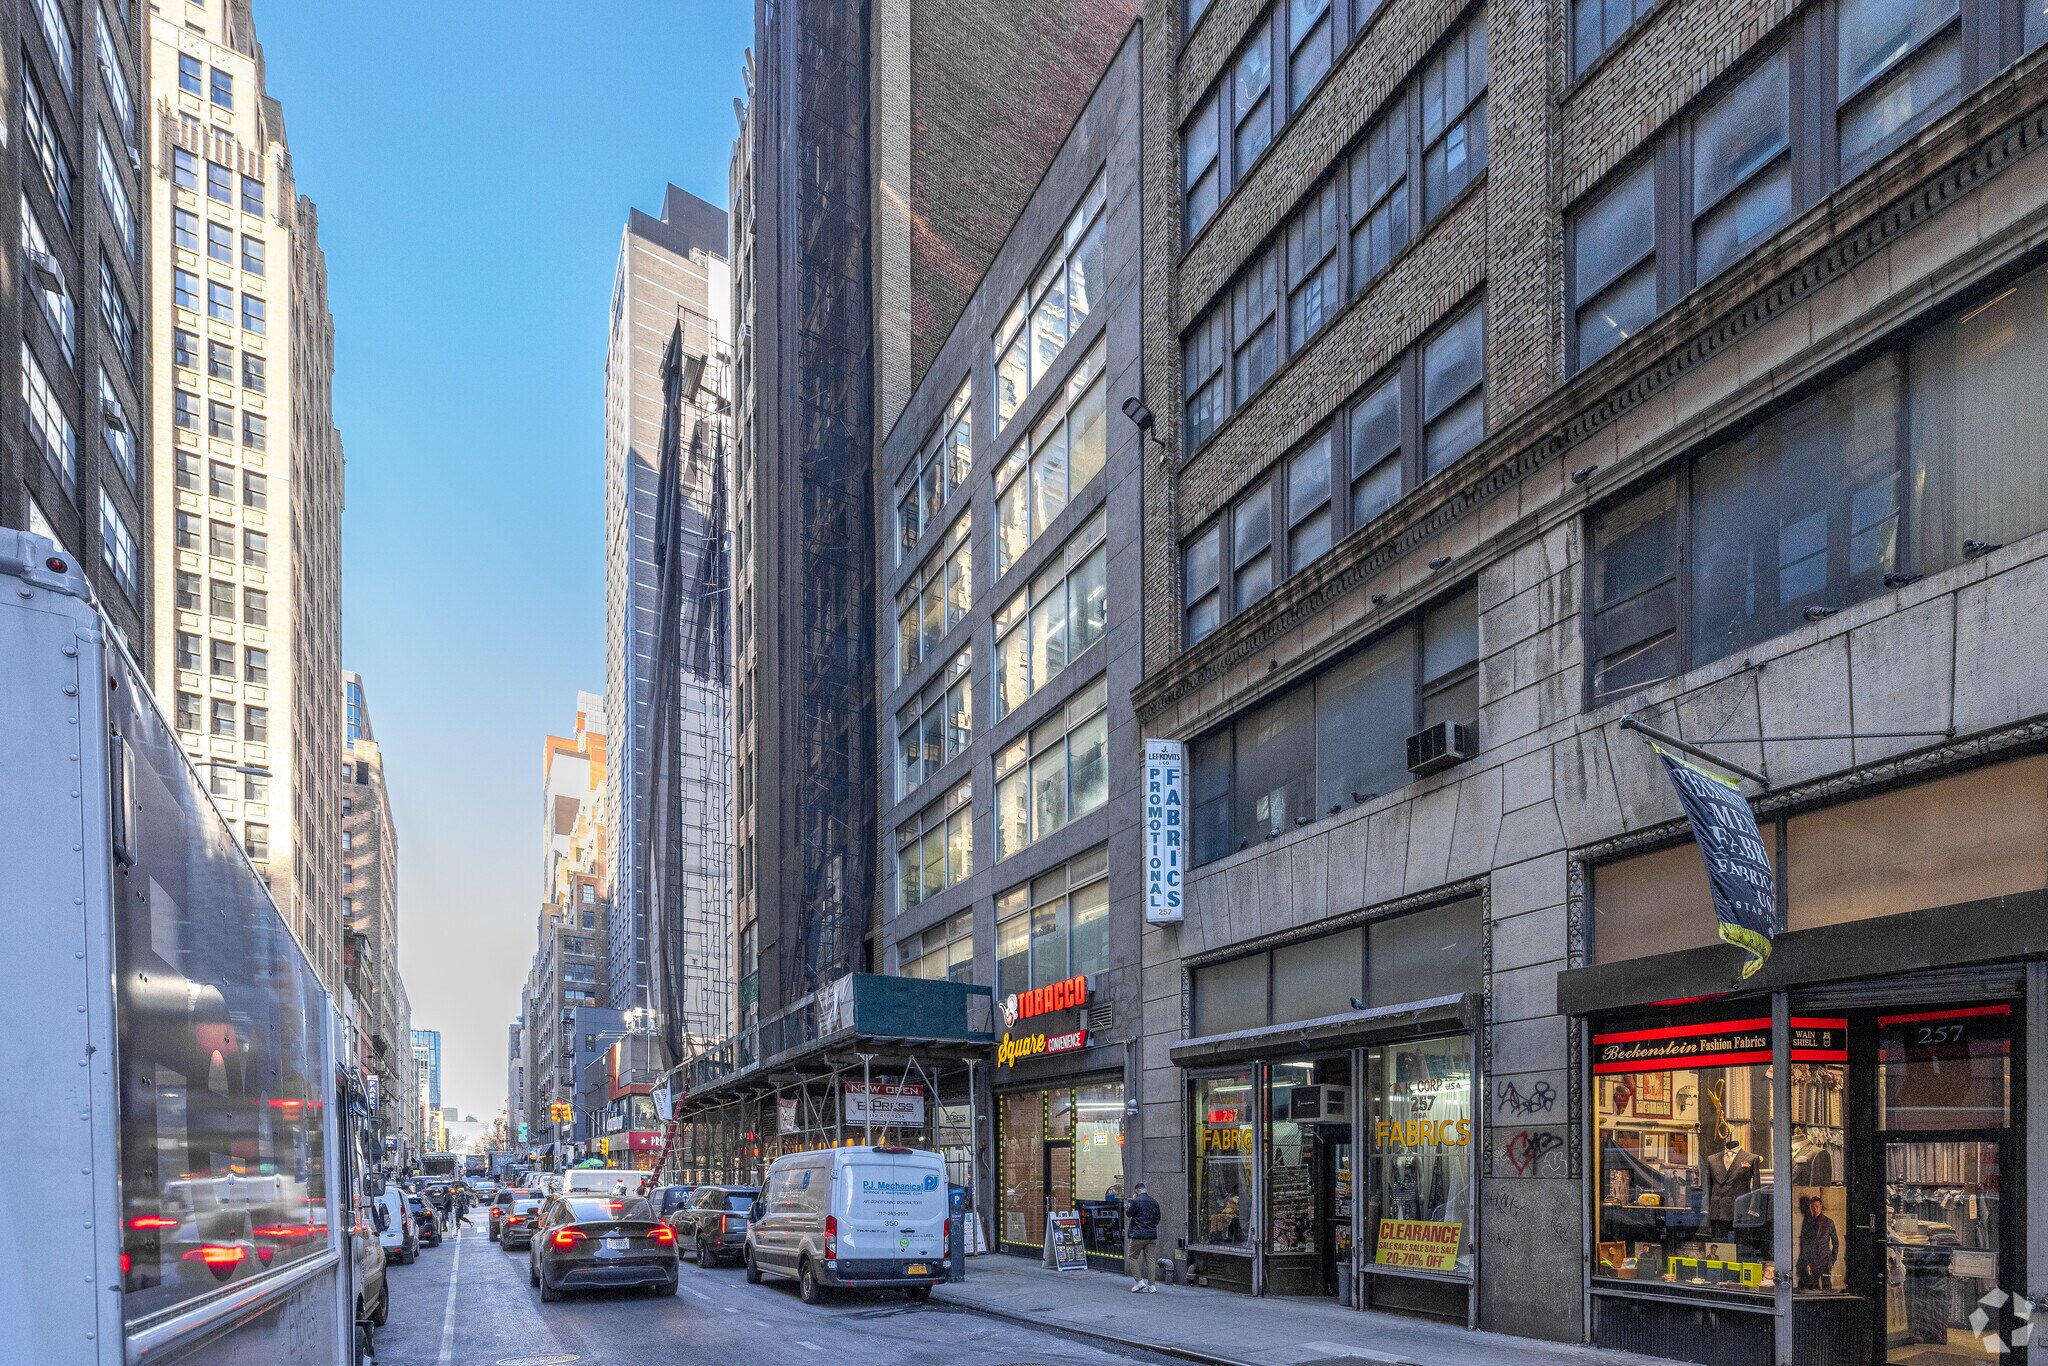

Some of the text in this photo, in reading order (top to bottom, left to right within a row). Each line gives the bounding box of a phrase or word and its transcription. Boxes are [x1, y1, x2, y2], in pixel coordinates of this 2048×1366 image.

[1148, 753, 1181, 761] LEFKOVITS
[1148, 768, 1162, 907] PROMOTIONAL
[1166, 769, 1182, 908] FABRICS
[1158, 908, 1172, 916] 257
[1018, 974, 1086, 1020] TOBACCO
[1795, 1030, 1816, 1039] WAIN
[1918, 1025, 1964, 1044] 257
[998, 1032, 1081, 1068] Square CONVENIENCE
[1602, 1036, 1766, 1061] Beckenstein Fashion Fabrics
[1792, 1039, 1818, 1047] SHIELL
[886, 1086, 918, 1094] OPEN
[1410, 1096, 1436, 1112] 257
[1222, 1109, 1238, 1122] 257
[1376, 1119, 1470, 1147] FABRICS
[863, 1180, 876, 1189] P.J.
[878, 1181, 923, 1191] Mechanical
[954, 1196, 960, 1204] P
[1380, 1222, 1460, 1244] CLEARANCE
[1378, 1242, 1456, 1254] SALE SALE SALE SALE SALE
[1386, 1252, 1444, 1268] 20-70% OFF
